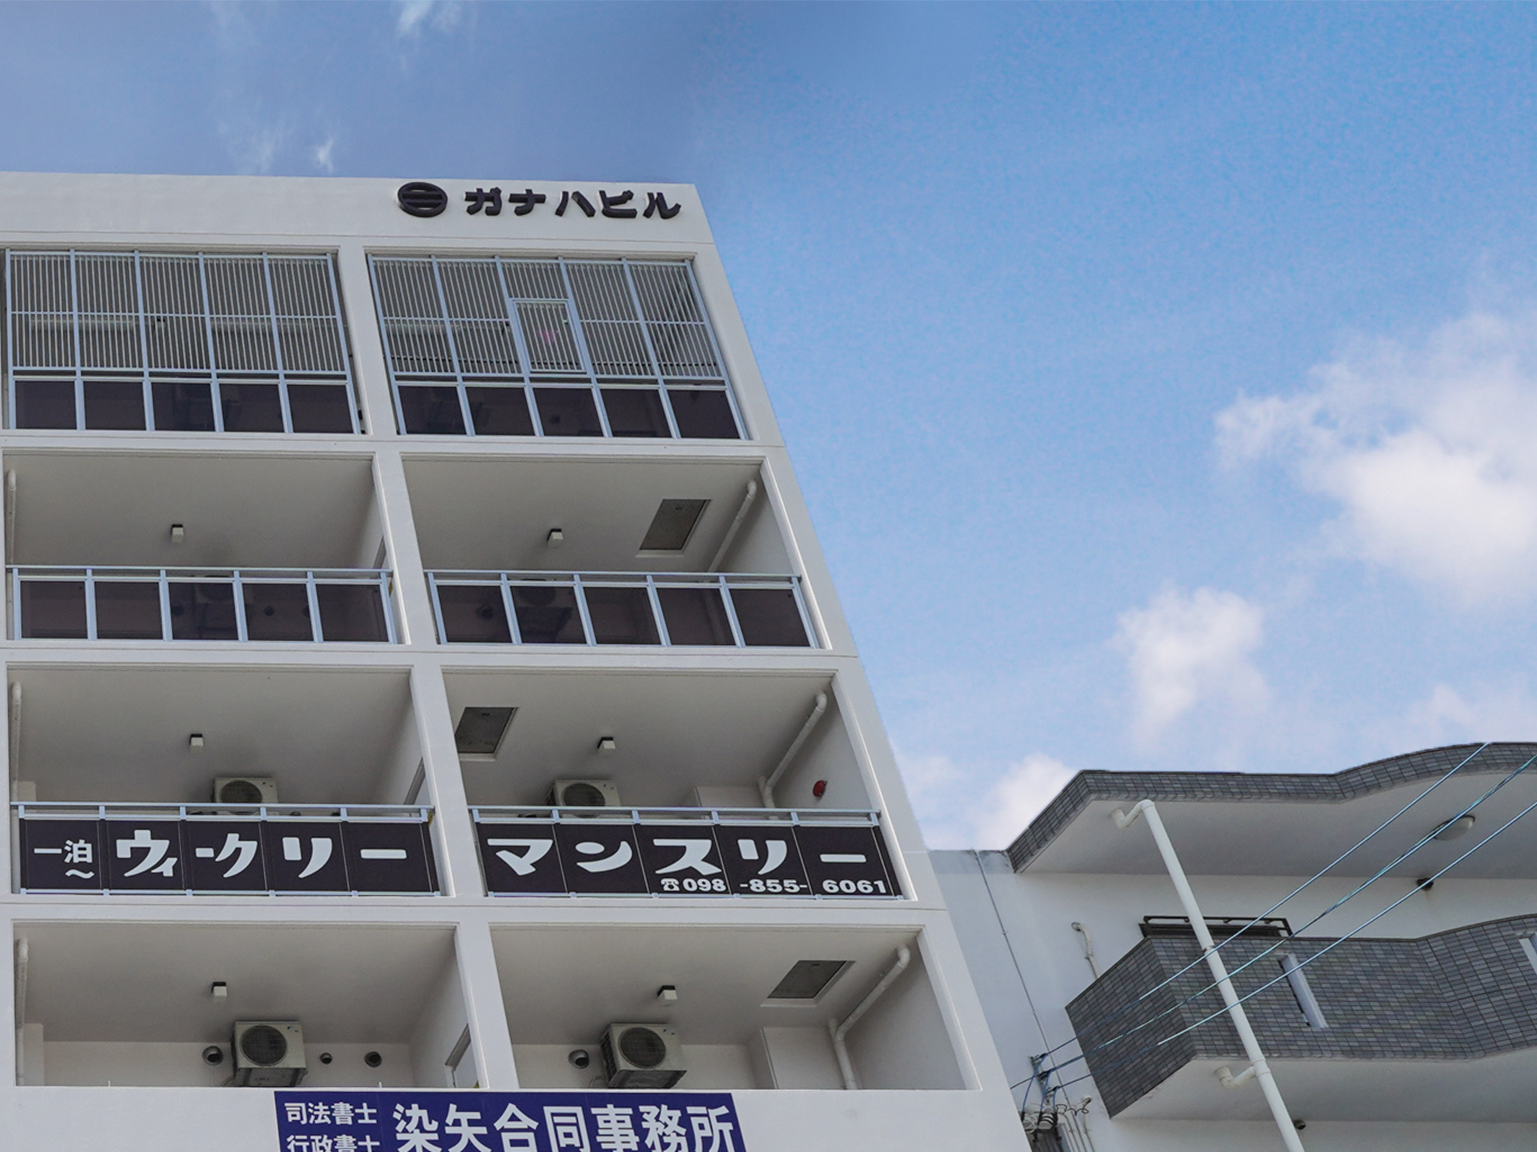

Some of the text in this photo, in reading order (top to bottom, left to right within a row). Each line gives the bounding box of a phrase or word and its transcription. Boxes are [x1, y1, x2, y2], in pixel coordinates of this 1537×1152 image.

[464, 187, 682, 219] ガナハビル
[115, 829, 408, 879] ウィークリー
[487, 836, 867, 877] マンスリー
[284, 1102, 377, 1126] 司法書士
